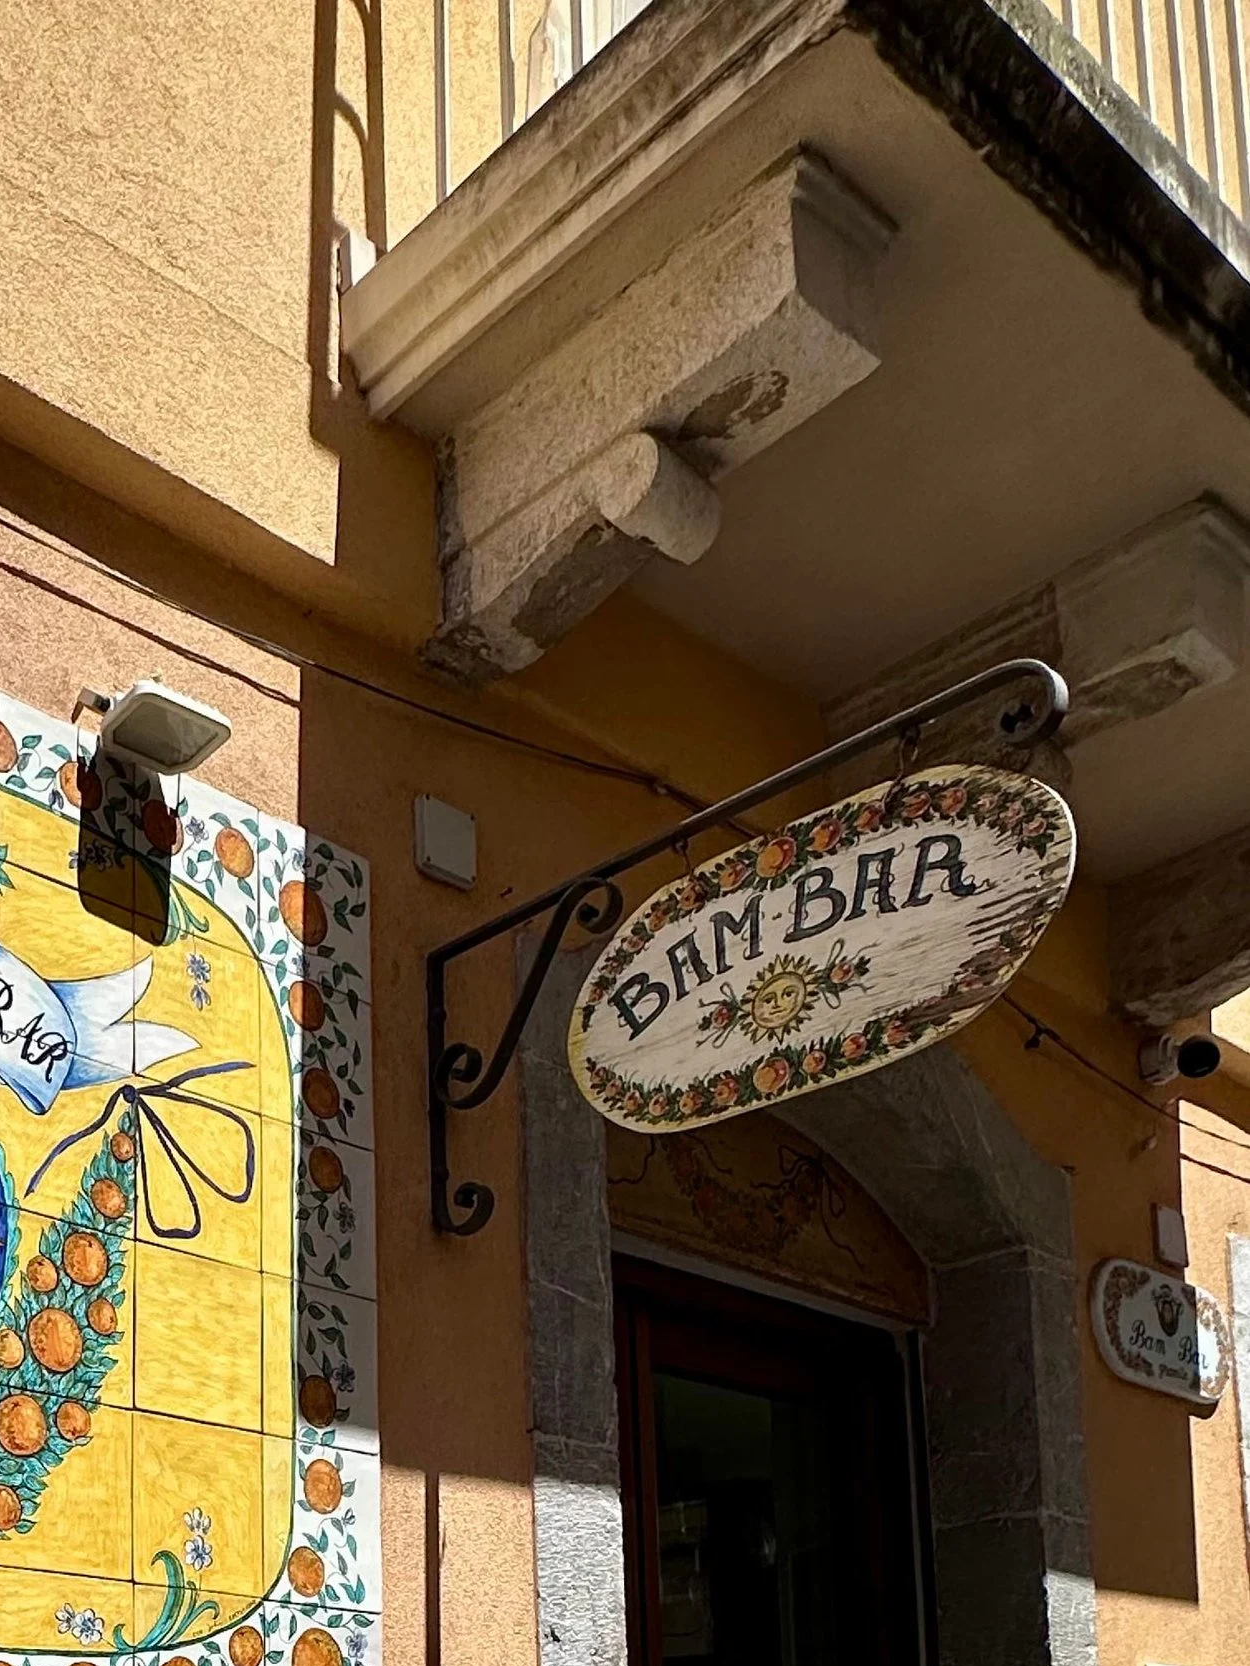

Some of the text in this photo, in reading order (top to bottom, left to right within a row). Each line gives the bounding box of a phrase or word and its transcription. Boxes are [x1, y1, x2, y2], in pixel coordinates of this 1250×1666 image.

[606, 834, 980, 1041] BAM BAR
[1129, 1319, 1166, 1355] Bam
